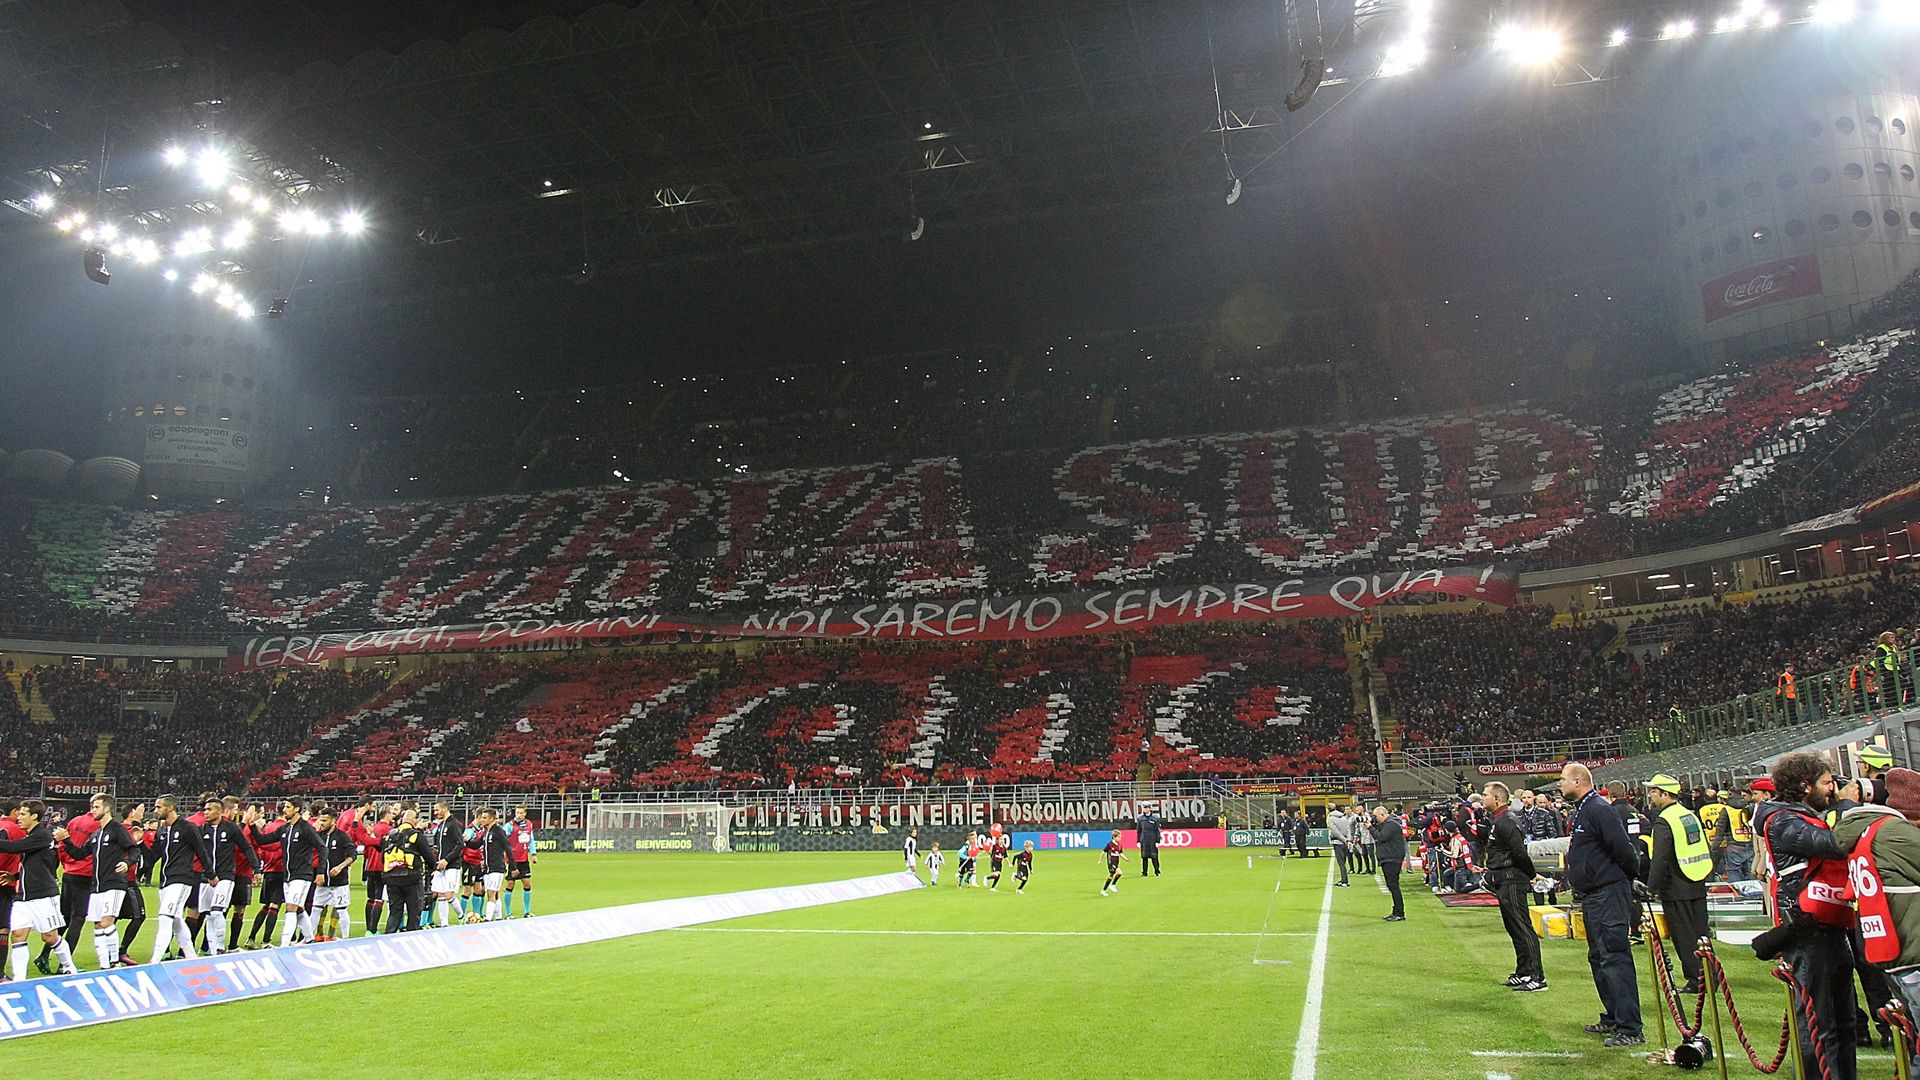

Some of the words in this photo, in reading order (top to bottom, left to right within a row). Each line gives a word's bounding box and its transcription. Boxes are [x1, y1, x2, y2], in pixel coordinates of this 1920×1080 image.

[168, 425, 229, 437] ecoprogram
[851, 596, 1063, 638] SAREMO
[1084, 579, 1304, 630] SEMPRE
[1329, 568, 1445, 612] QUA
[1001, 801, 1100, 821] TOSCOLANO
[1058, 832, 1090, 848] TIM
[1254, 830, 1283, 838] BANCA
[635, 840, 692, 850] BIENVENIDOS
[292, 893, 299, 903] 6
[1812, 885, 1844, 900] RIC
[214, 894, 226, 906] 12
[103, 902, 110, 914] 5
[215, 960, 288, 993] TIM
